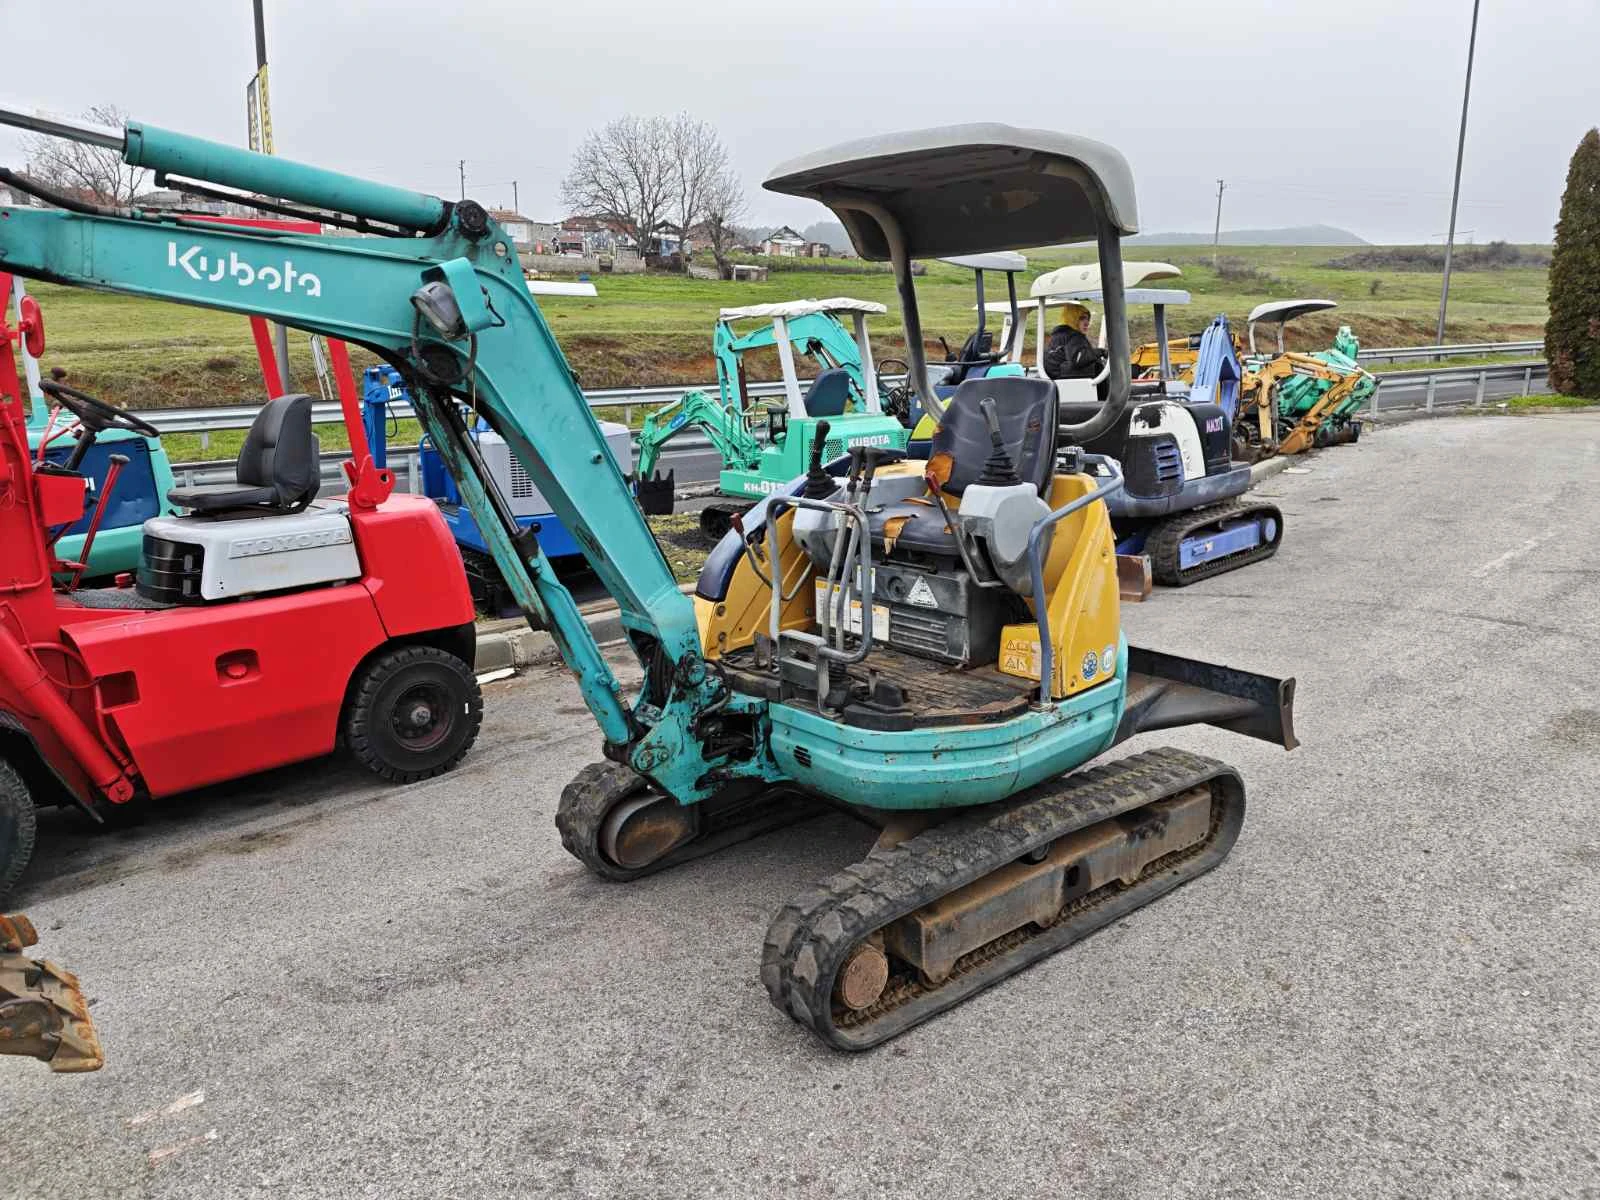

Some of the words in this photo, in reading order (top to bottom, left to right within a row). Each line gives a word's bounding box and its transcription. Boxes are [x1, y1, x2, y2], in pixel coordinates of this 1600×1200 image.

[168, 241, 321, 297] Kubota
[848, 434, 890, 448] KUBOTA
[235, 529, 350, 554] TOYOTA
